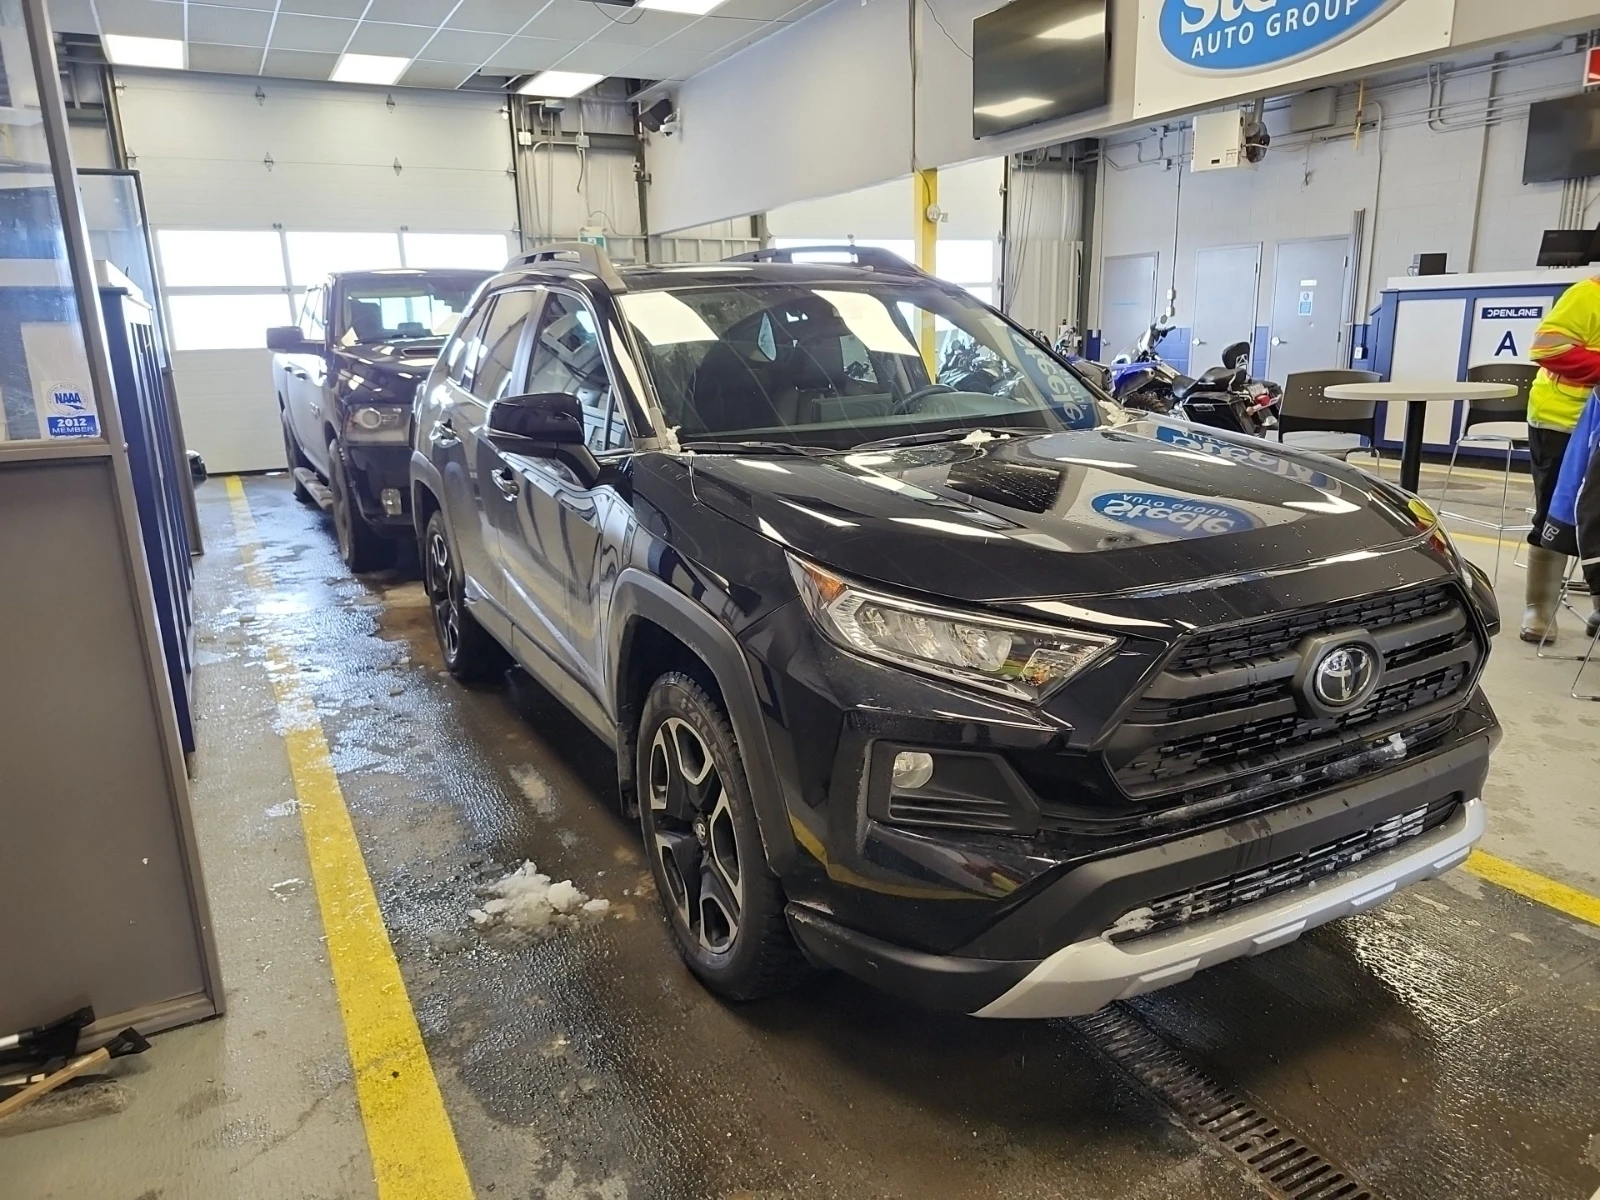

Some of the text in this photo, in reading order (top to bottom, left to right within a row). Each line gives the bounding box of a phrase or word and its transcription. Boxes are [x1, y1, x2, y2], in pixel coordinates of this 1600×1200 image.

[1191, 0, 1360, 59] AUTO GROUP
[1486, 308, 1539, 318] OPENLANE
[1494, 331, 1518, 357] A
[54, 392, 82, 404] NAAA
[56, 417, 88, 427] 2012
[51, 426, 95, 434] MEMBER
